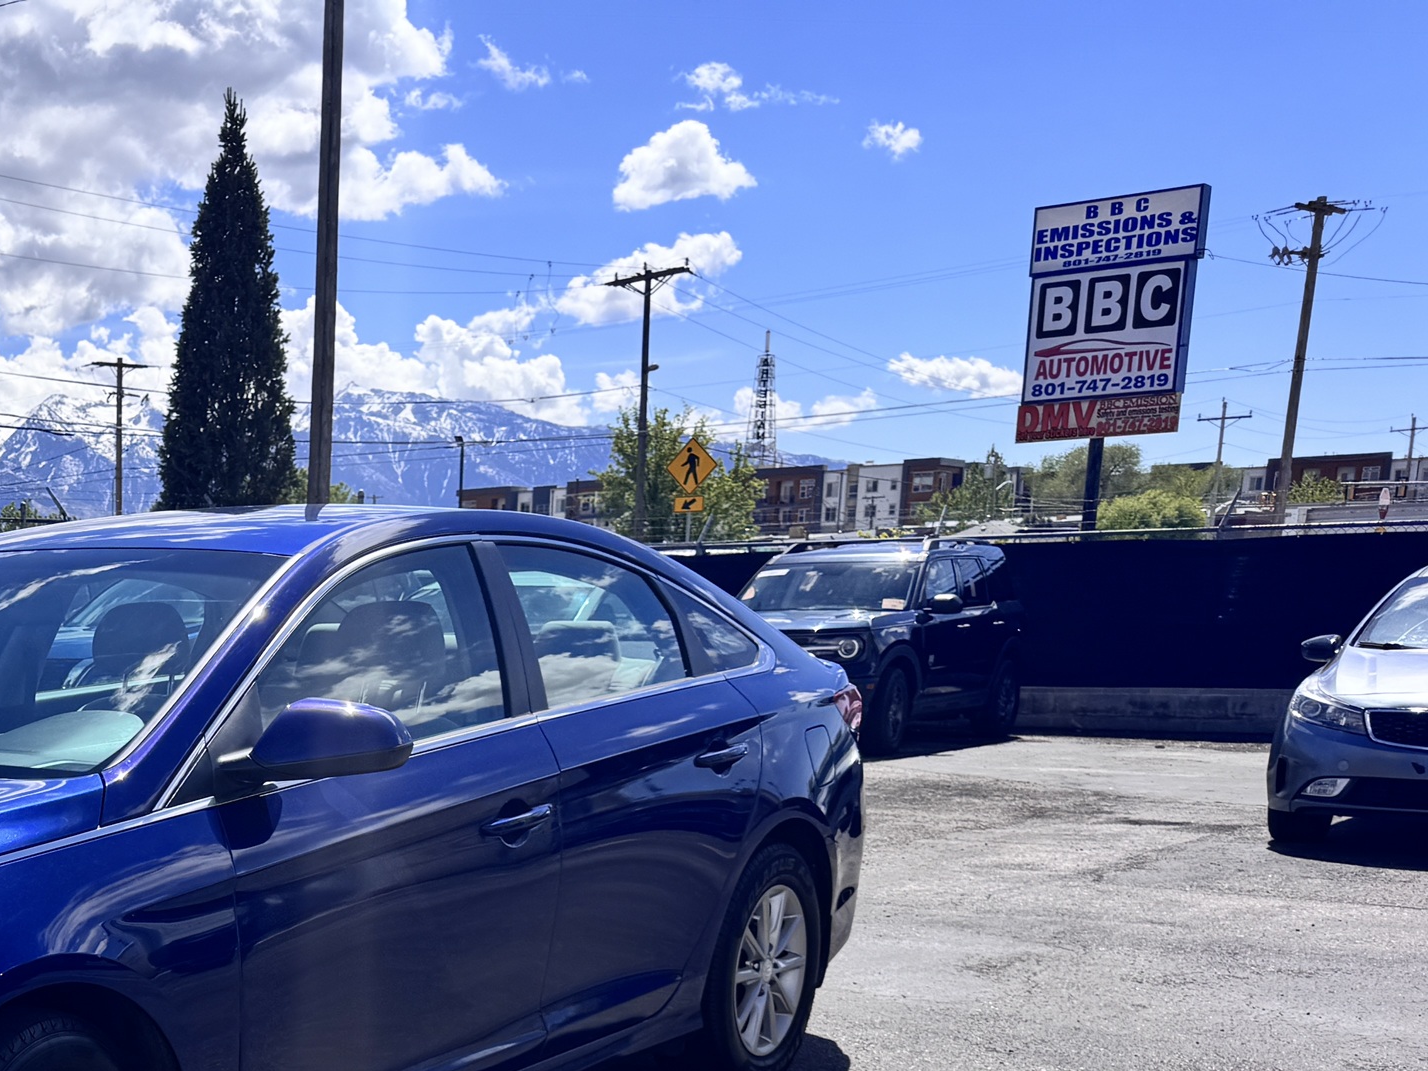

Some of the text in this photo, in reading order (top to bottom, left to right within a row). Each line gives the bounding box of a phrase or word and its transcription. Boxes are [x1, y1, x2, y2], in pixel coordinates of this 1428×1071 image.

[1034, 226, 1198, 262] INSPECTIONS
[1036, 211, 1198, 245] EMISSIONS &
[1062, 248, 1162, 268] 801-747-2819
[1042, 274, 1173, 332] BBC
[1034, 347, 1173, 381] AUTOMOTIVE
[1031, 373, 1169, 397] 801-747-2819
[1124, 394, 1178, 408] EMISSION
[1018, 400, 1098, 434] DMV
